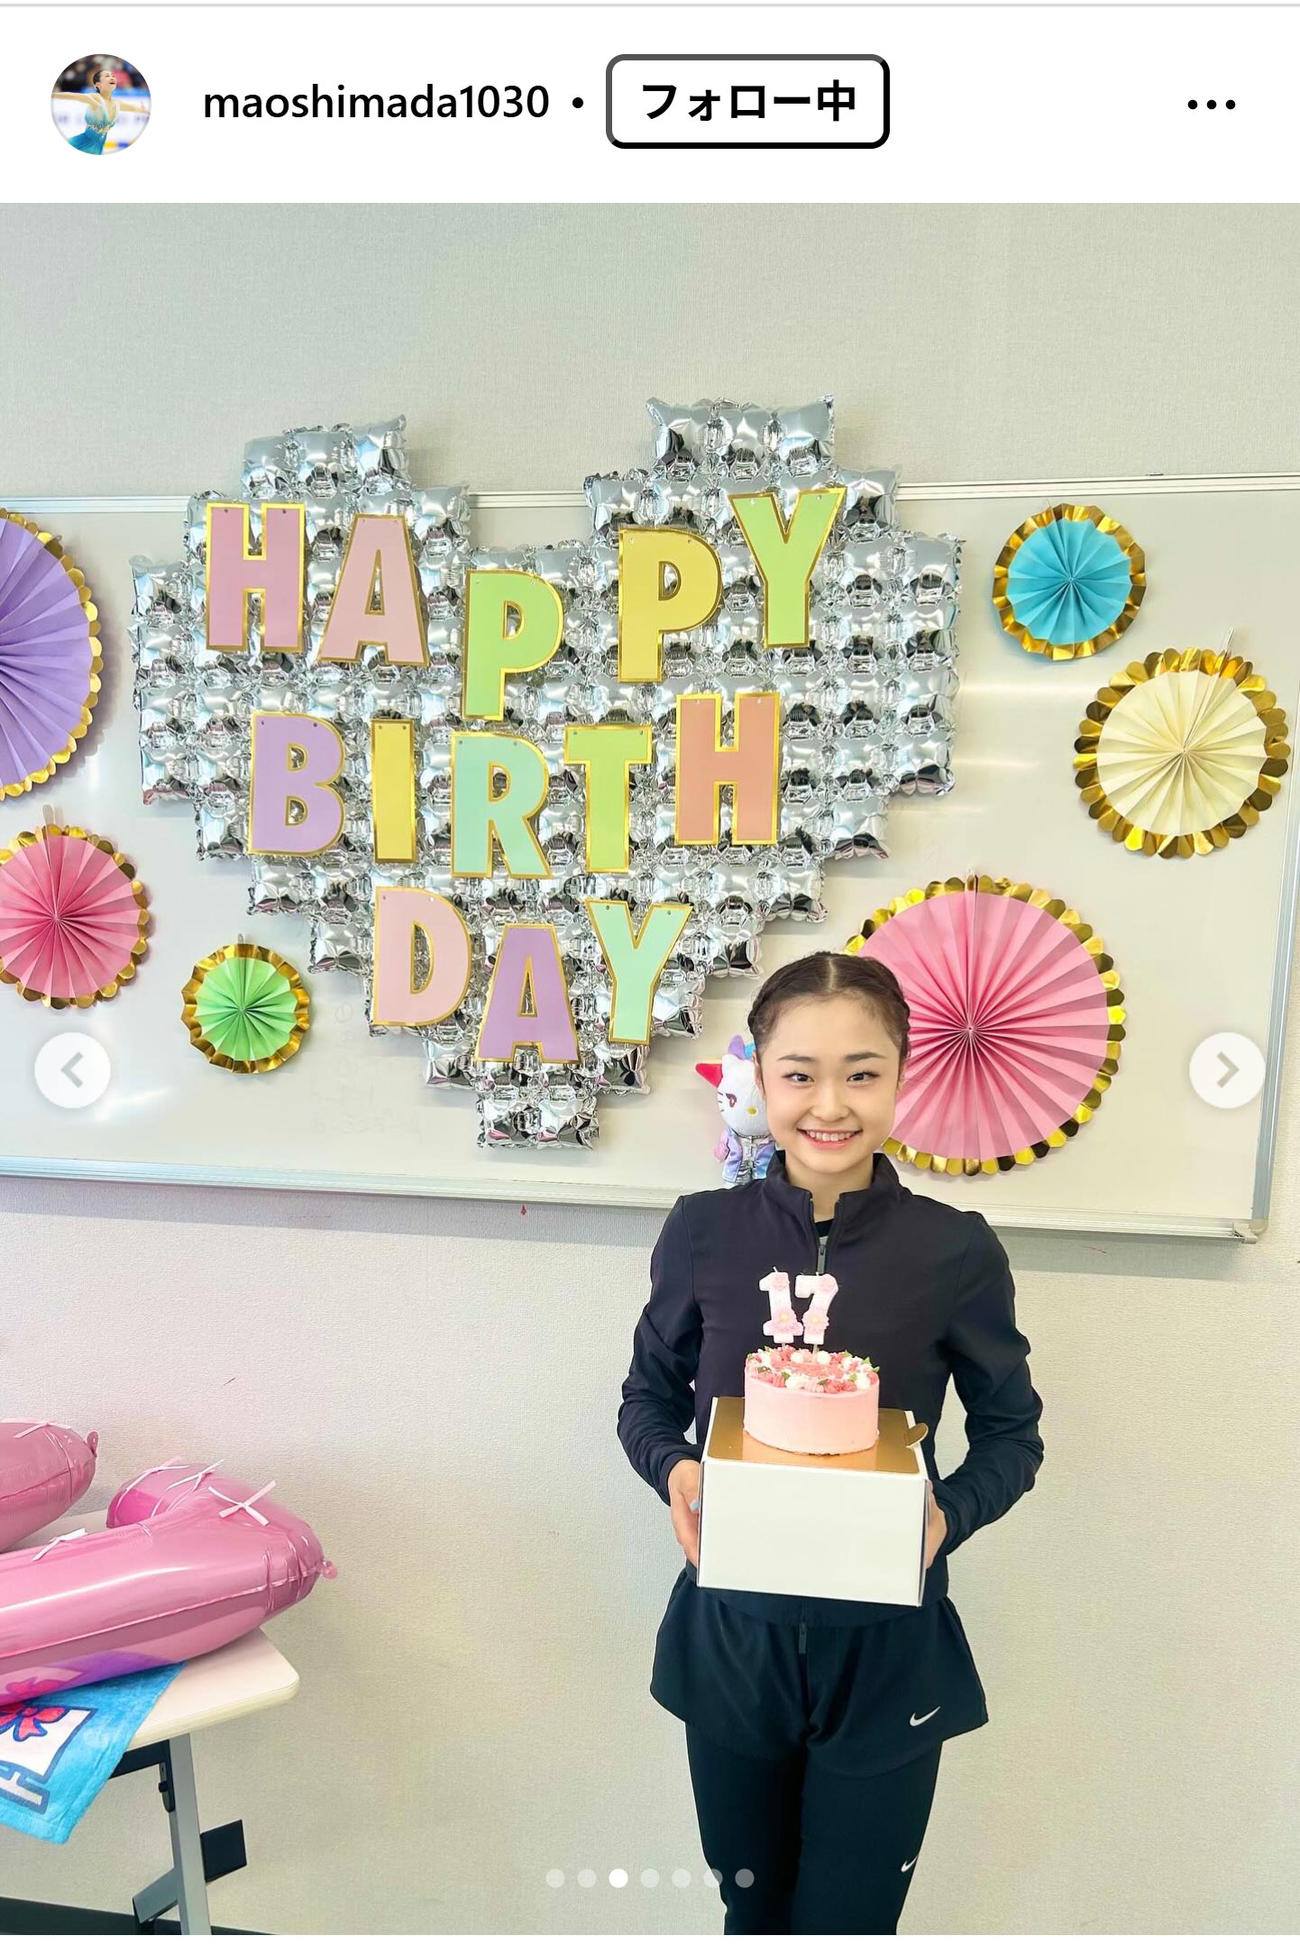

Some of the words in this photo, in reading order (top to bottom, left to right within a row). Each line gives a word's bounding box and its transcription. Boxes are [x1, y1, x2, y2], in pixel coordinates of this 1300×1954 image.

[206, 488, 847, 721] HAPPY
[249, 694, 782, 880] BIRTH
[373, 888, 689, 1063] DAY
[758, 1271, 839, 1345] 17
